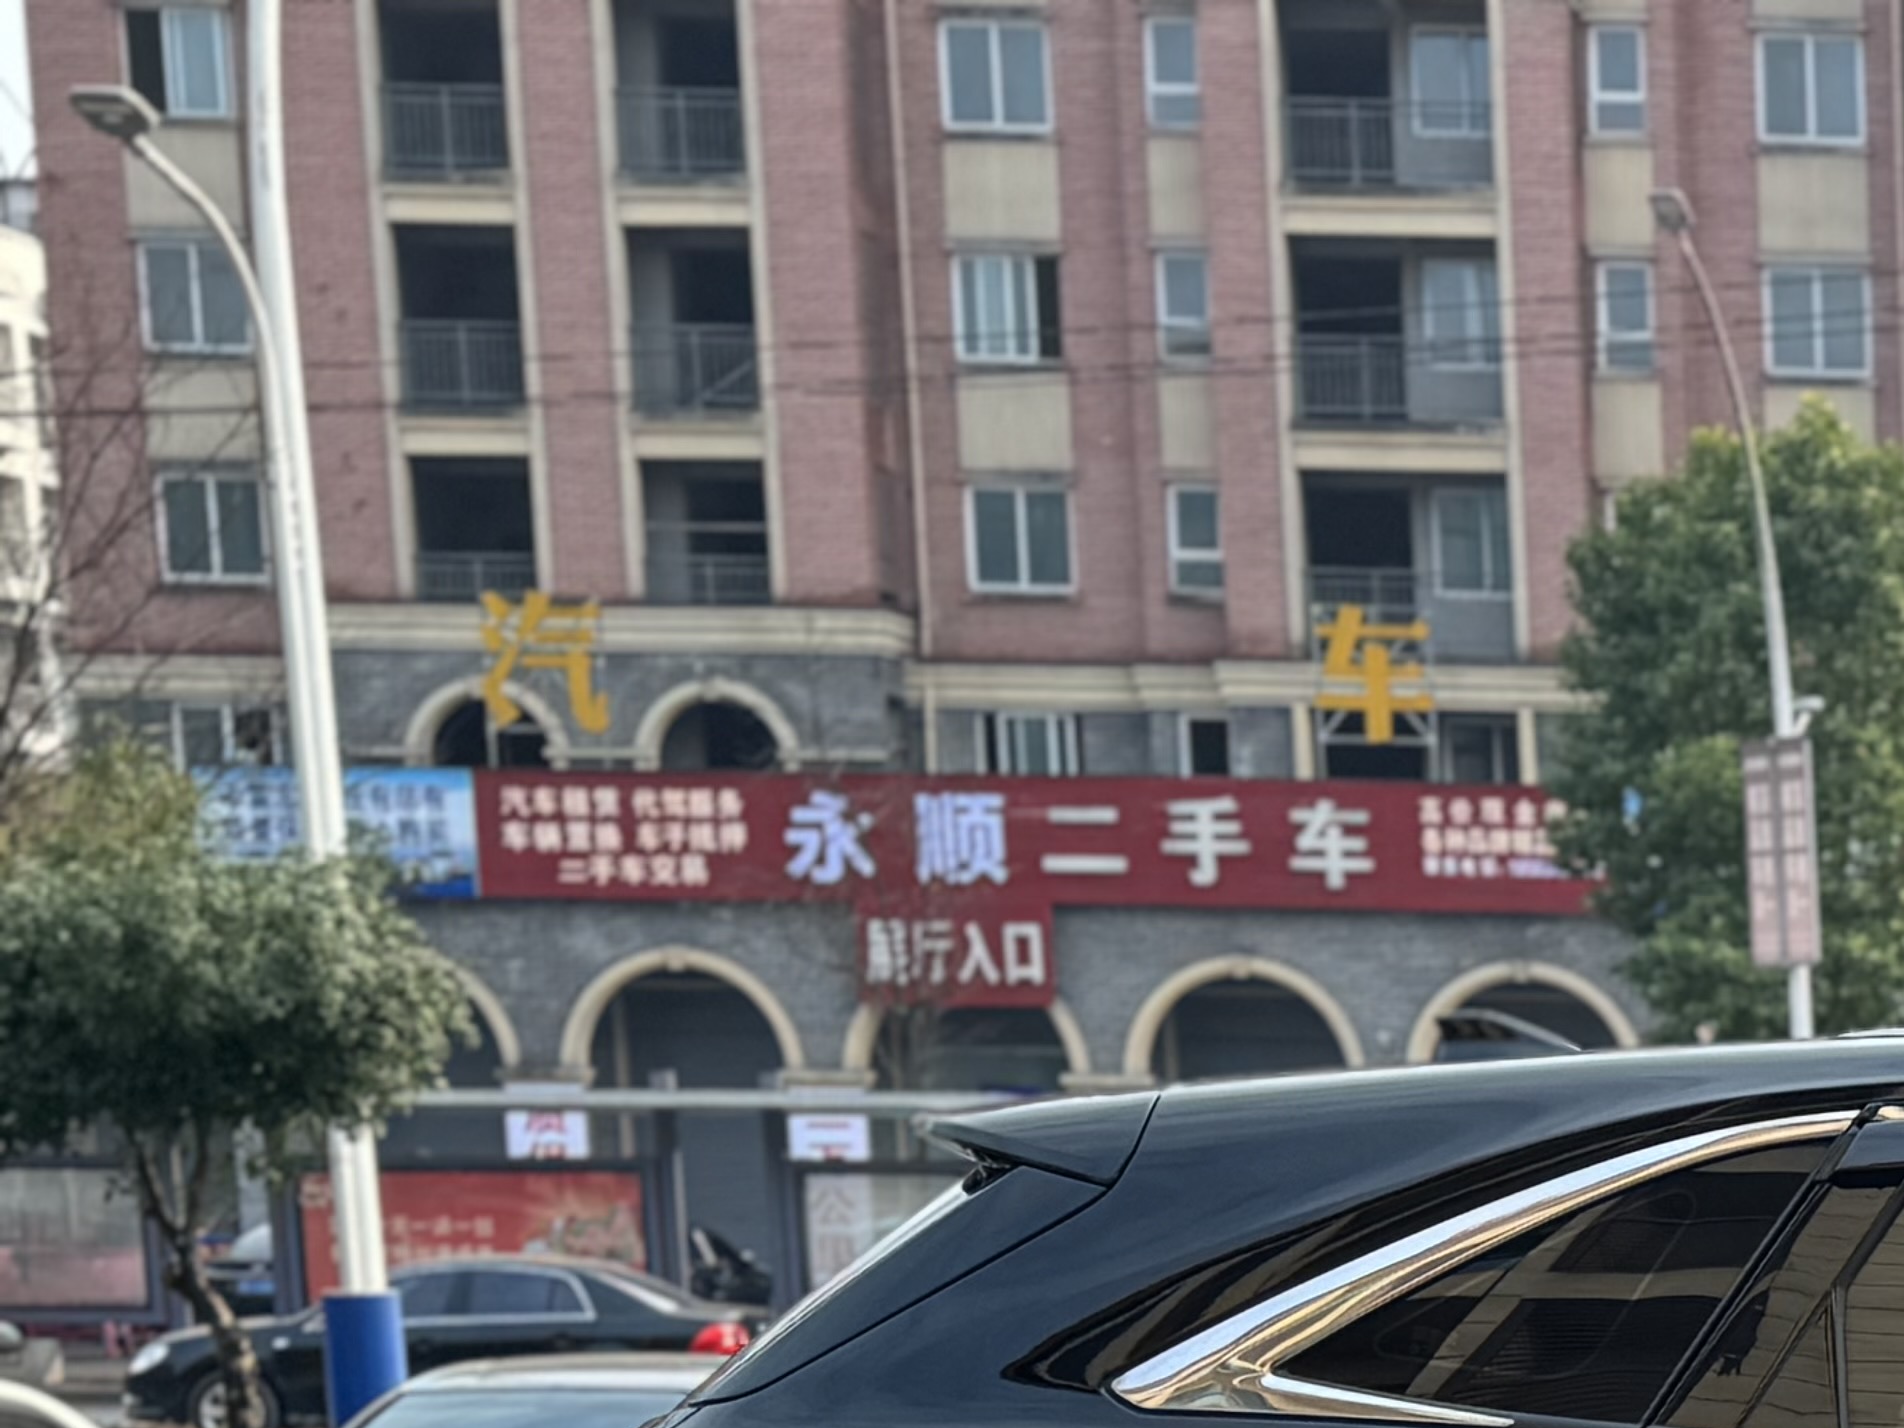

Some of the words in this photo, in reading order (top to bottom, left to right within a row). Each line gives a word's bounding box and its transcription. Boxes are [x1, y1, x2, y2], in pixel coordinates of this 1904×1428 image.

[480, 588, 610, 733] 汽
[1315, 604, 1436, 744] 车
[783, 790, 1378, 892] 永顺二手车
